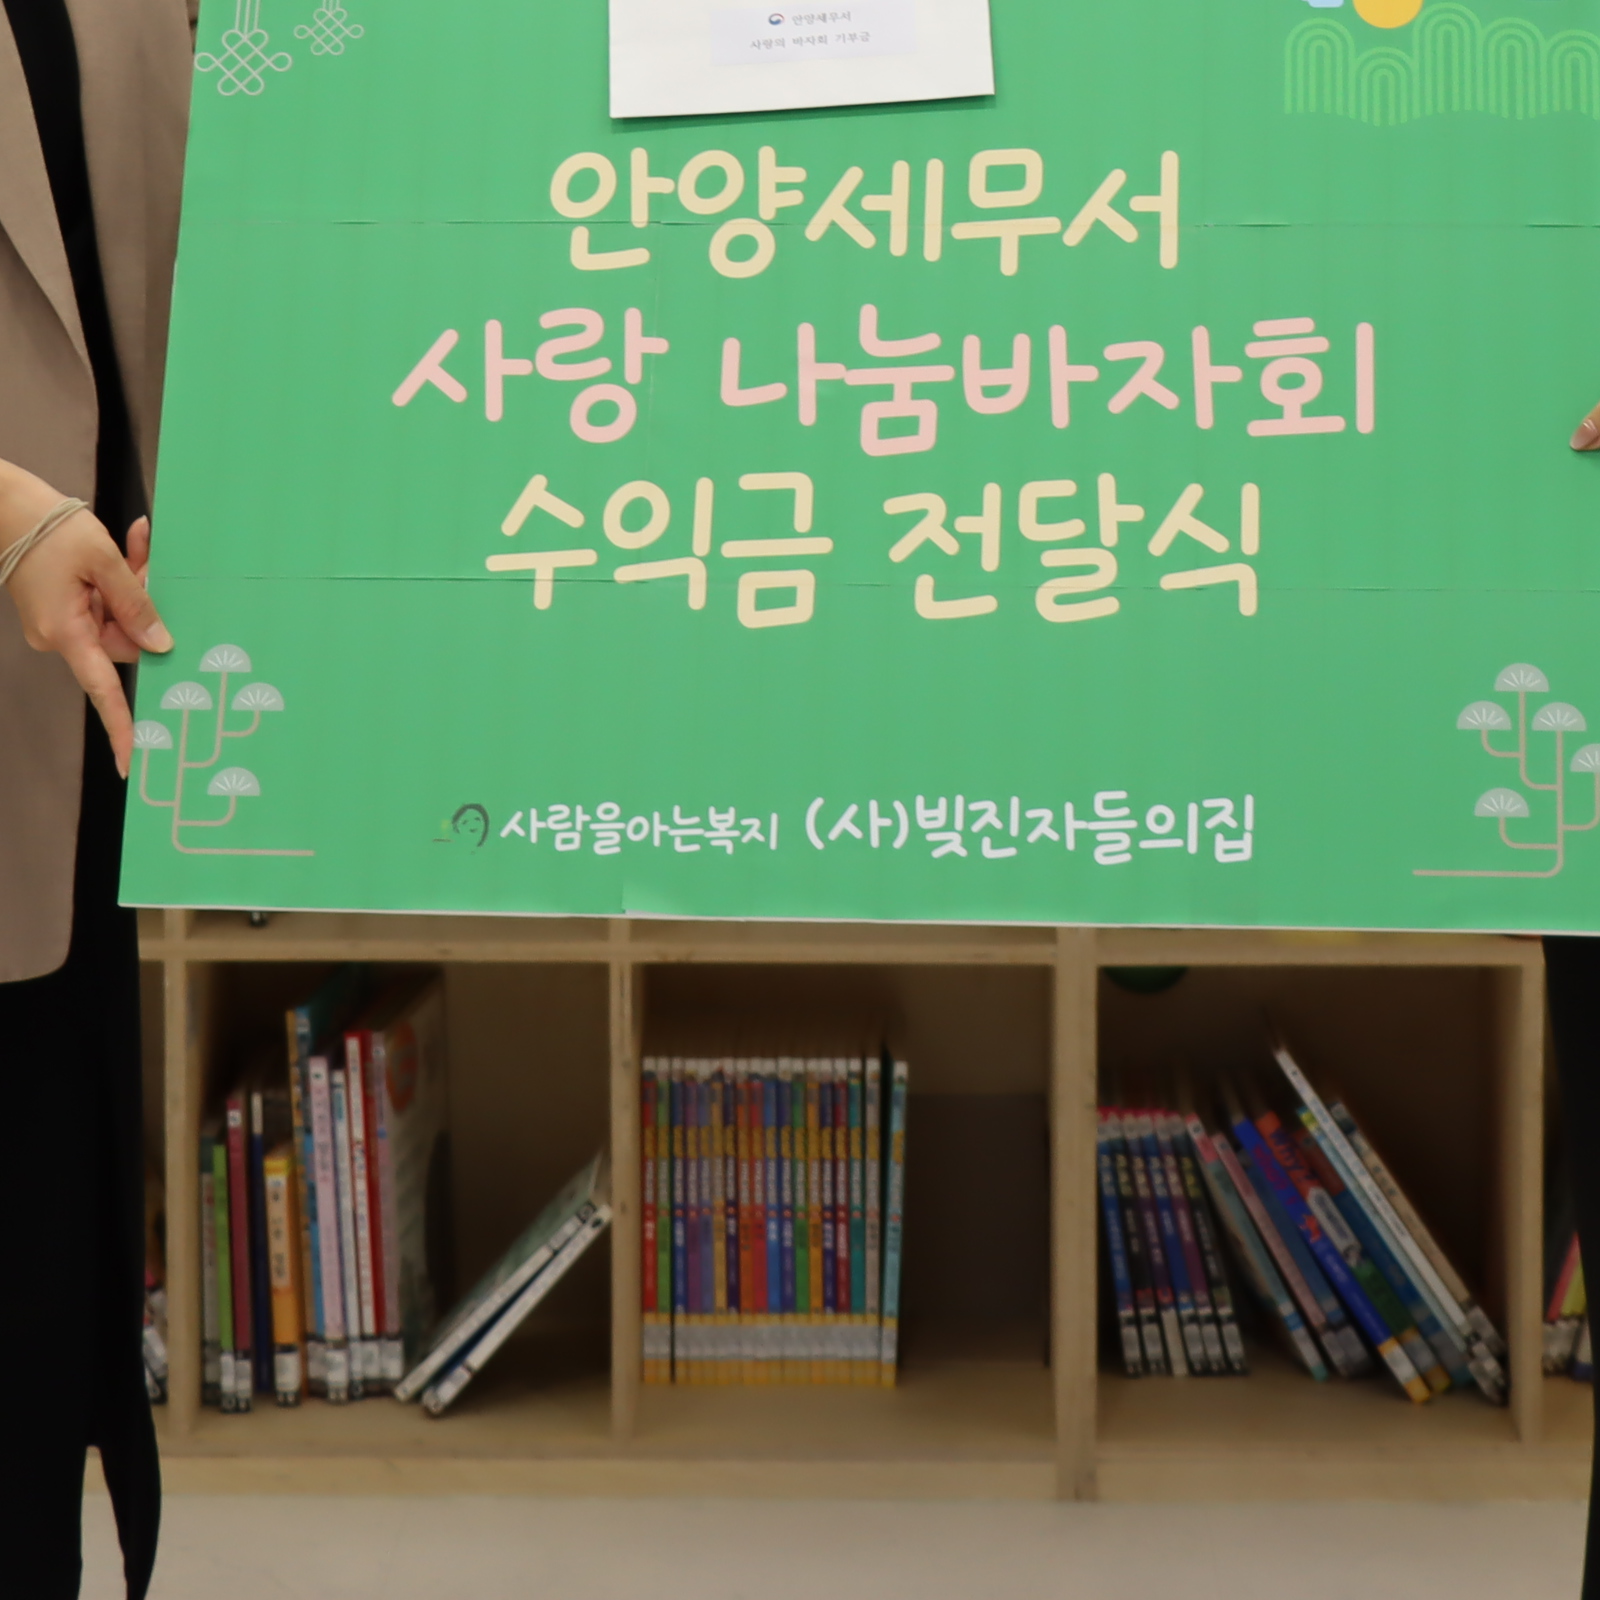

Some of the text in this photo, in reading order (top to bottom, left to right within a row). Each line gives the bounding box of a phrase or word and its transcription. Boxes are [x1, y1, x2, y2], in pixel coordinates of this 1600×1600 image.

[750, 30, 871, 50] 사랑의 바자회 기부금
[791, 10, 852, 27] 안양세무서
[549, 145, 1179, 279] 안양세무서
[391, 303, 1375, 457] 사랑 나눔바자회
[485, 472, 1260, 628] 수익금 전달식
[500, 789, 1257, 866] 사람을아는복지 (사)빚진자들의집
